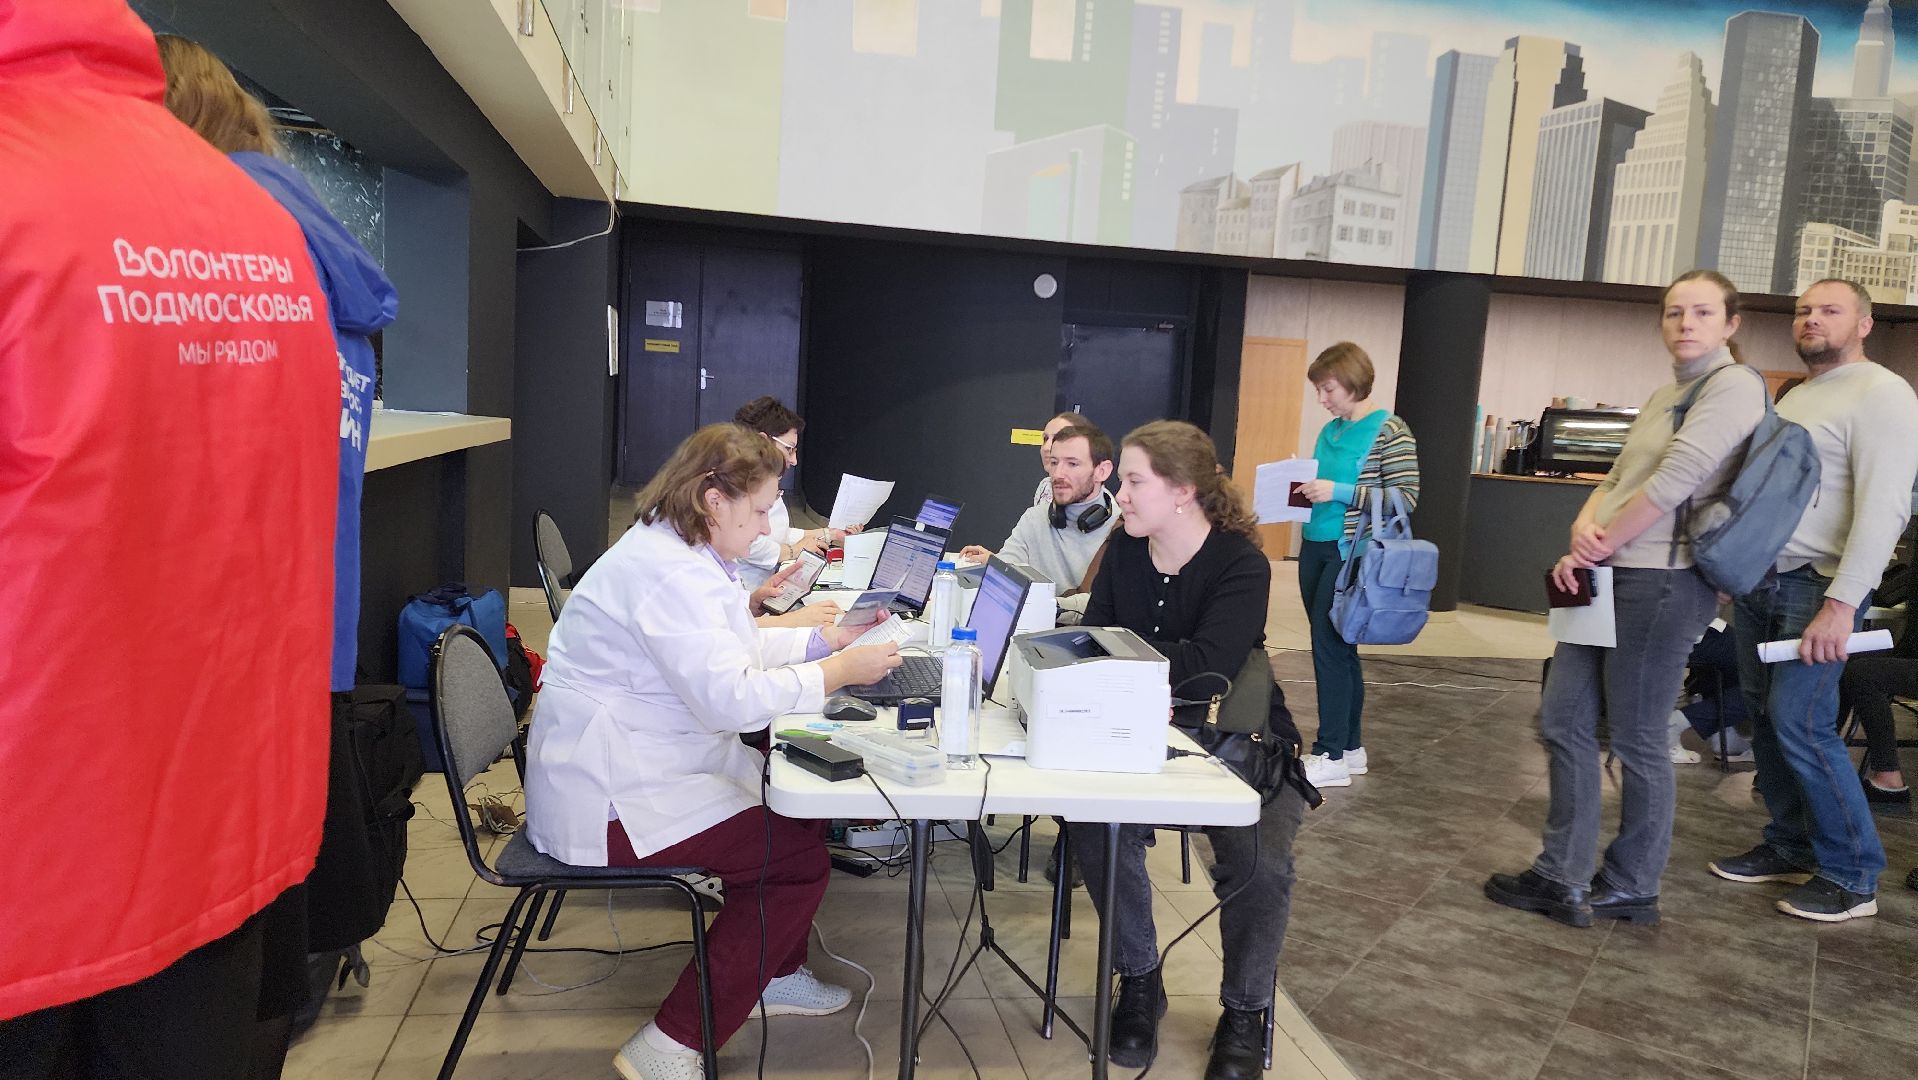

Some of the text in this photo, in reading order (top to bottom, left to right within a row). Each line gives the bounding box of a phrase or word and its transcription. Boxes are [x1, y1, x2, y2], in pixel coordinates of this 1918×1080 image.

[113, 238, 294, 283] ВОЛОНТЕРЫ
[97, 285, 314, 325] ПОДМОСКОВЬЯ
[178, 339, 278, 365] МЫ РЯДОМ
